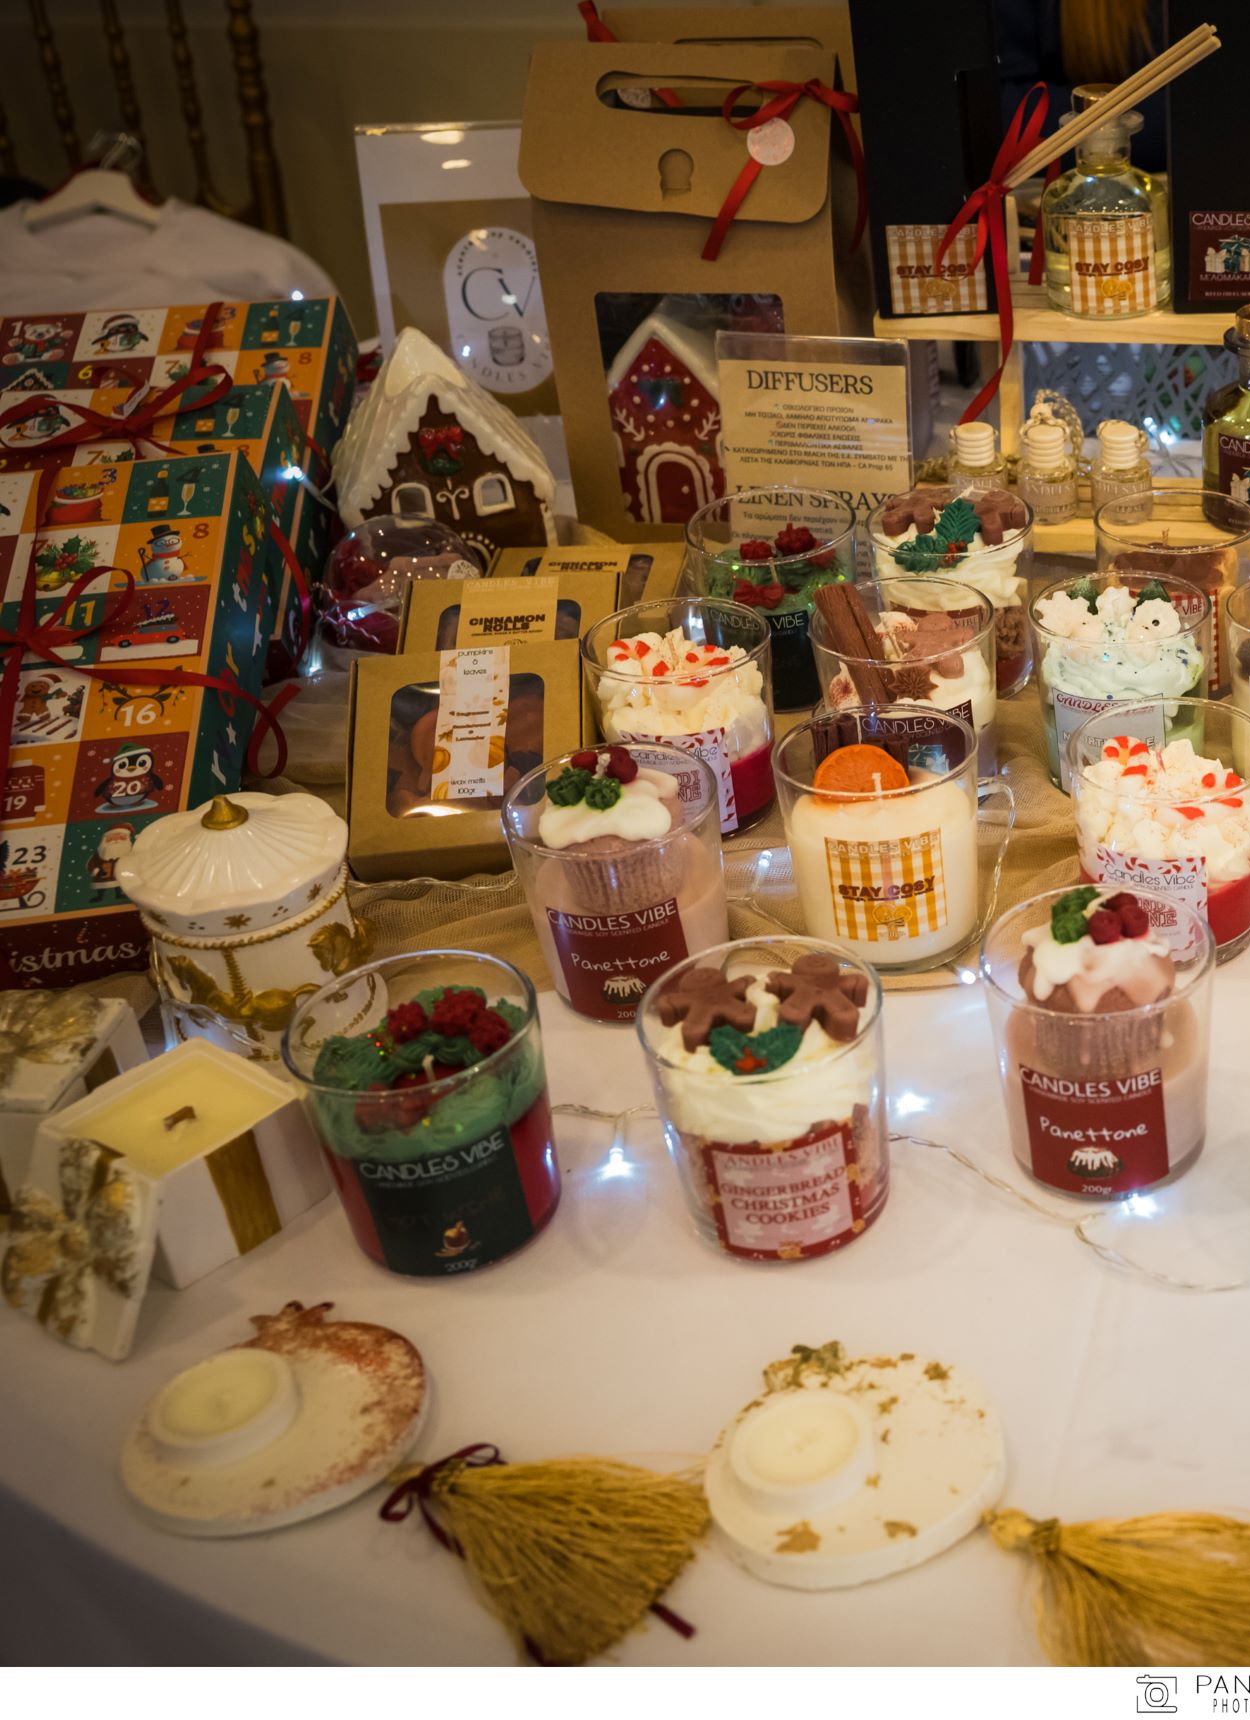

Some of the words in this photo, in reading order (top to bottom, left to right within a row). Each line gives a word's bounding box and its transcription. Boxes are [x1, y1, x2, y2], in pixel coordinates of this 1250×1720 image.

[896, 264, 932, 276] STAY
[1075, 262, 1110, 274] STAY
[1114, 256, 1149, 273] COSY
[165, 360, 180, 375] 7
[298, 352, 312, 365] 8
[78, 365, 93, 380] 6
[746, 369, 874, 396] DIFFUSERS
[102, 467, 118, 484] 3
[735, 485, 804, 507] LINEN
[192, 522, 209, 539] 8
[469, 614, 546, 626] CINNAMON
[482, 622, 531, 633] ROLLS
[772, 612, 805, 630] VIBE
[463, 668, 487, 676] leaves
[120, 704, 157, 727] 16
[861, 717, 935, 734] CANDLES
[112, 780, 142, 797] 20
[467, 777, 486, 785] melts
[4, 795, 28, 811] 19
[829, 841, 900, 856] CANDLES
[905, 831, 940, 850] VIBE
[12, 846, 47, 866] 23
[1104, 861, 1161, 886] Candles
[1164, 874, 1196, 886] Vibe
[838, 884, 882, 898] STAY
[887, 875, 936, 897] COSY
[547, 910, 632, 932] CANDLES
[634, 899, 677, 925] VIBE
[9, 940, 142, 974] istmas
[570, 950, 671, 972] Panettone
[1019, 1067, 1112, 1098] CANDLES
[1116, 1068, 1163, 1095] VIBE
[1039, 1116, 1149, 1143] Panettone
[359, 1154, 460, 1181] CANDLES
[460, 1131, 506, 1164] VIBE
[720, 1165, 847, 1198] GINGERBREAD
[1081, 1183, 1114, 1195] 200gr
[731, 1181, 841, 1212] CHRISTMAS
[745, 1201, 832, 1226] COOKIES
